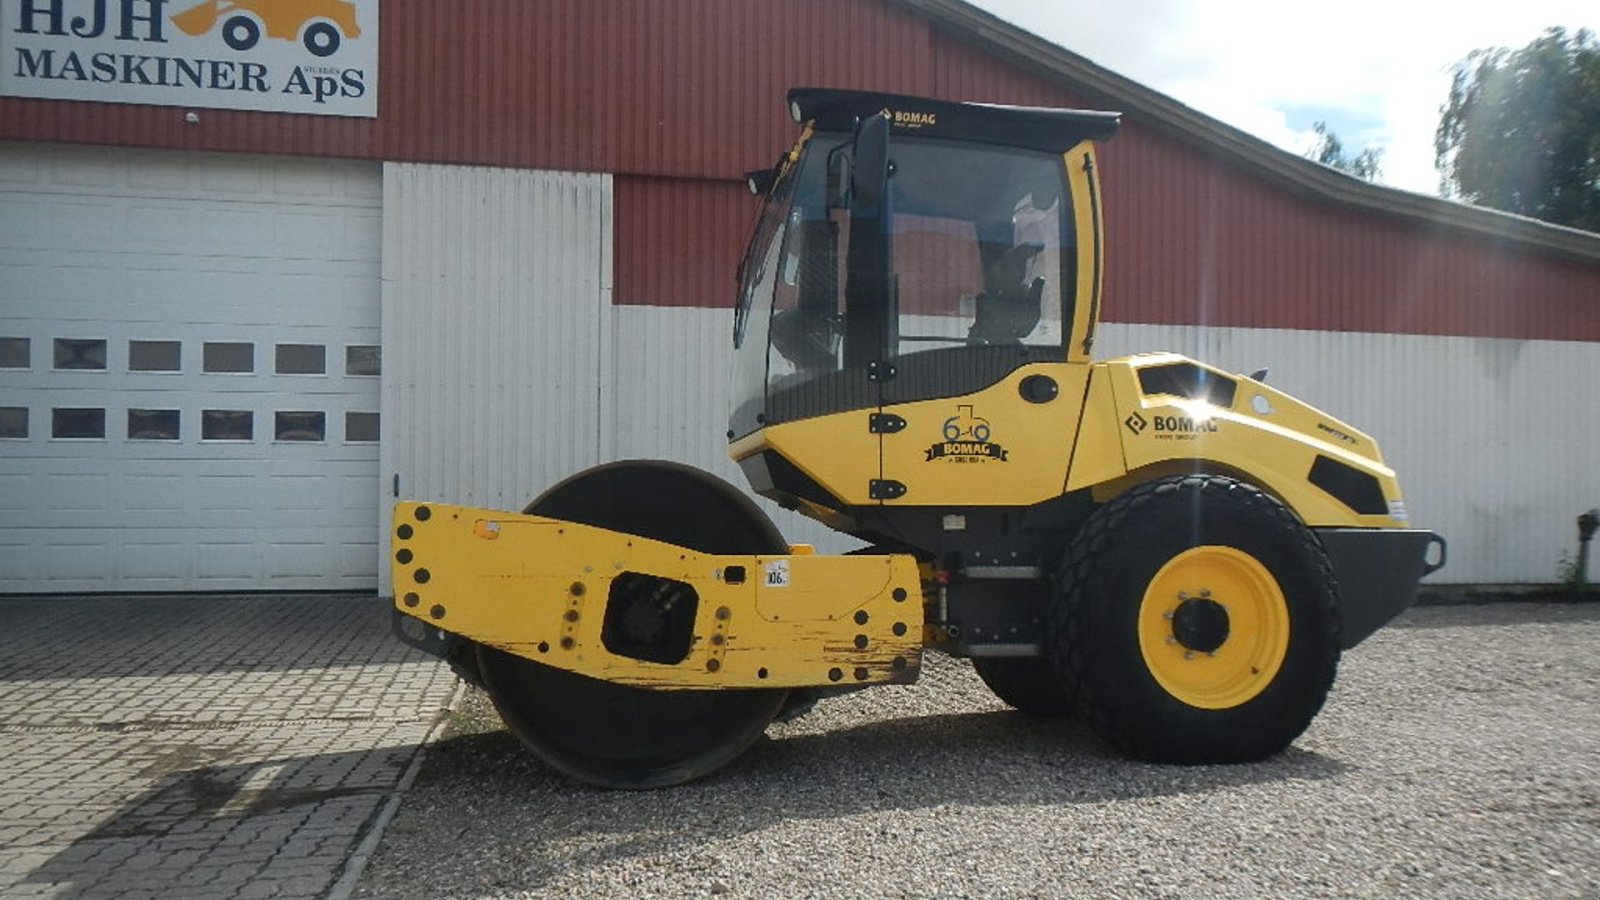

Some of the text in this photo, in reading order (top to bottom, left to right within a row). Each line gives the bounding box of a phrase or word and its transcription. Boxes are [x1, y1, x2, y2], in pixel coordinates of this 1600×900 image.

[14, 0, 169, 43] HJH
[14, 47, 366, 104] MASKINER ApS
[895, 111, 936, 125] BOMAG
[943, 443, 991, 455] BOMAG
